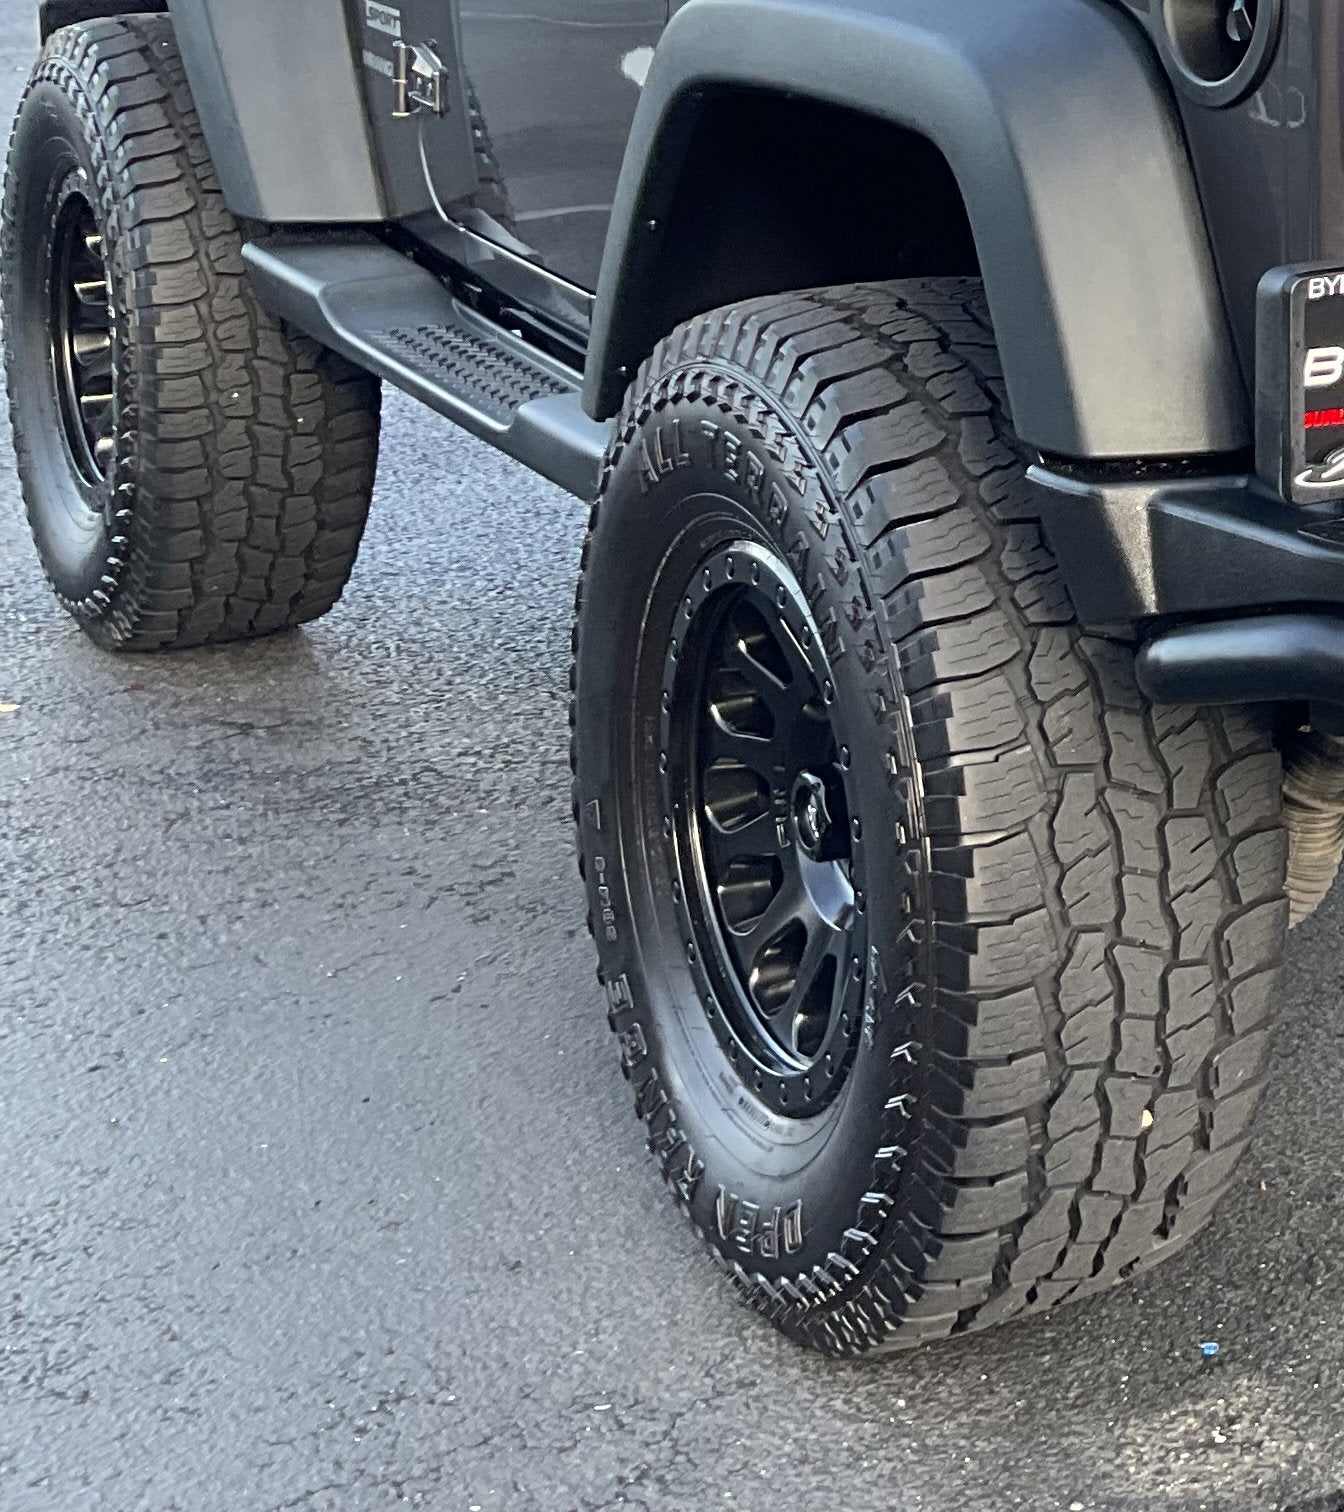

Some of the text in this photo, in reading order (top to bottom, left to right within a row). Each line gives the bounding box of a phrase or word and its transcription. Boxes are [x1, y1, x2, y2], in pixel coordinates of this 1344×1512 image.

[638, 417, 848, 670] ALL TERRAIN
[715, 1183, 804, 1260] OPEN
